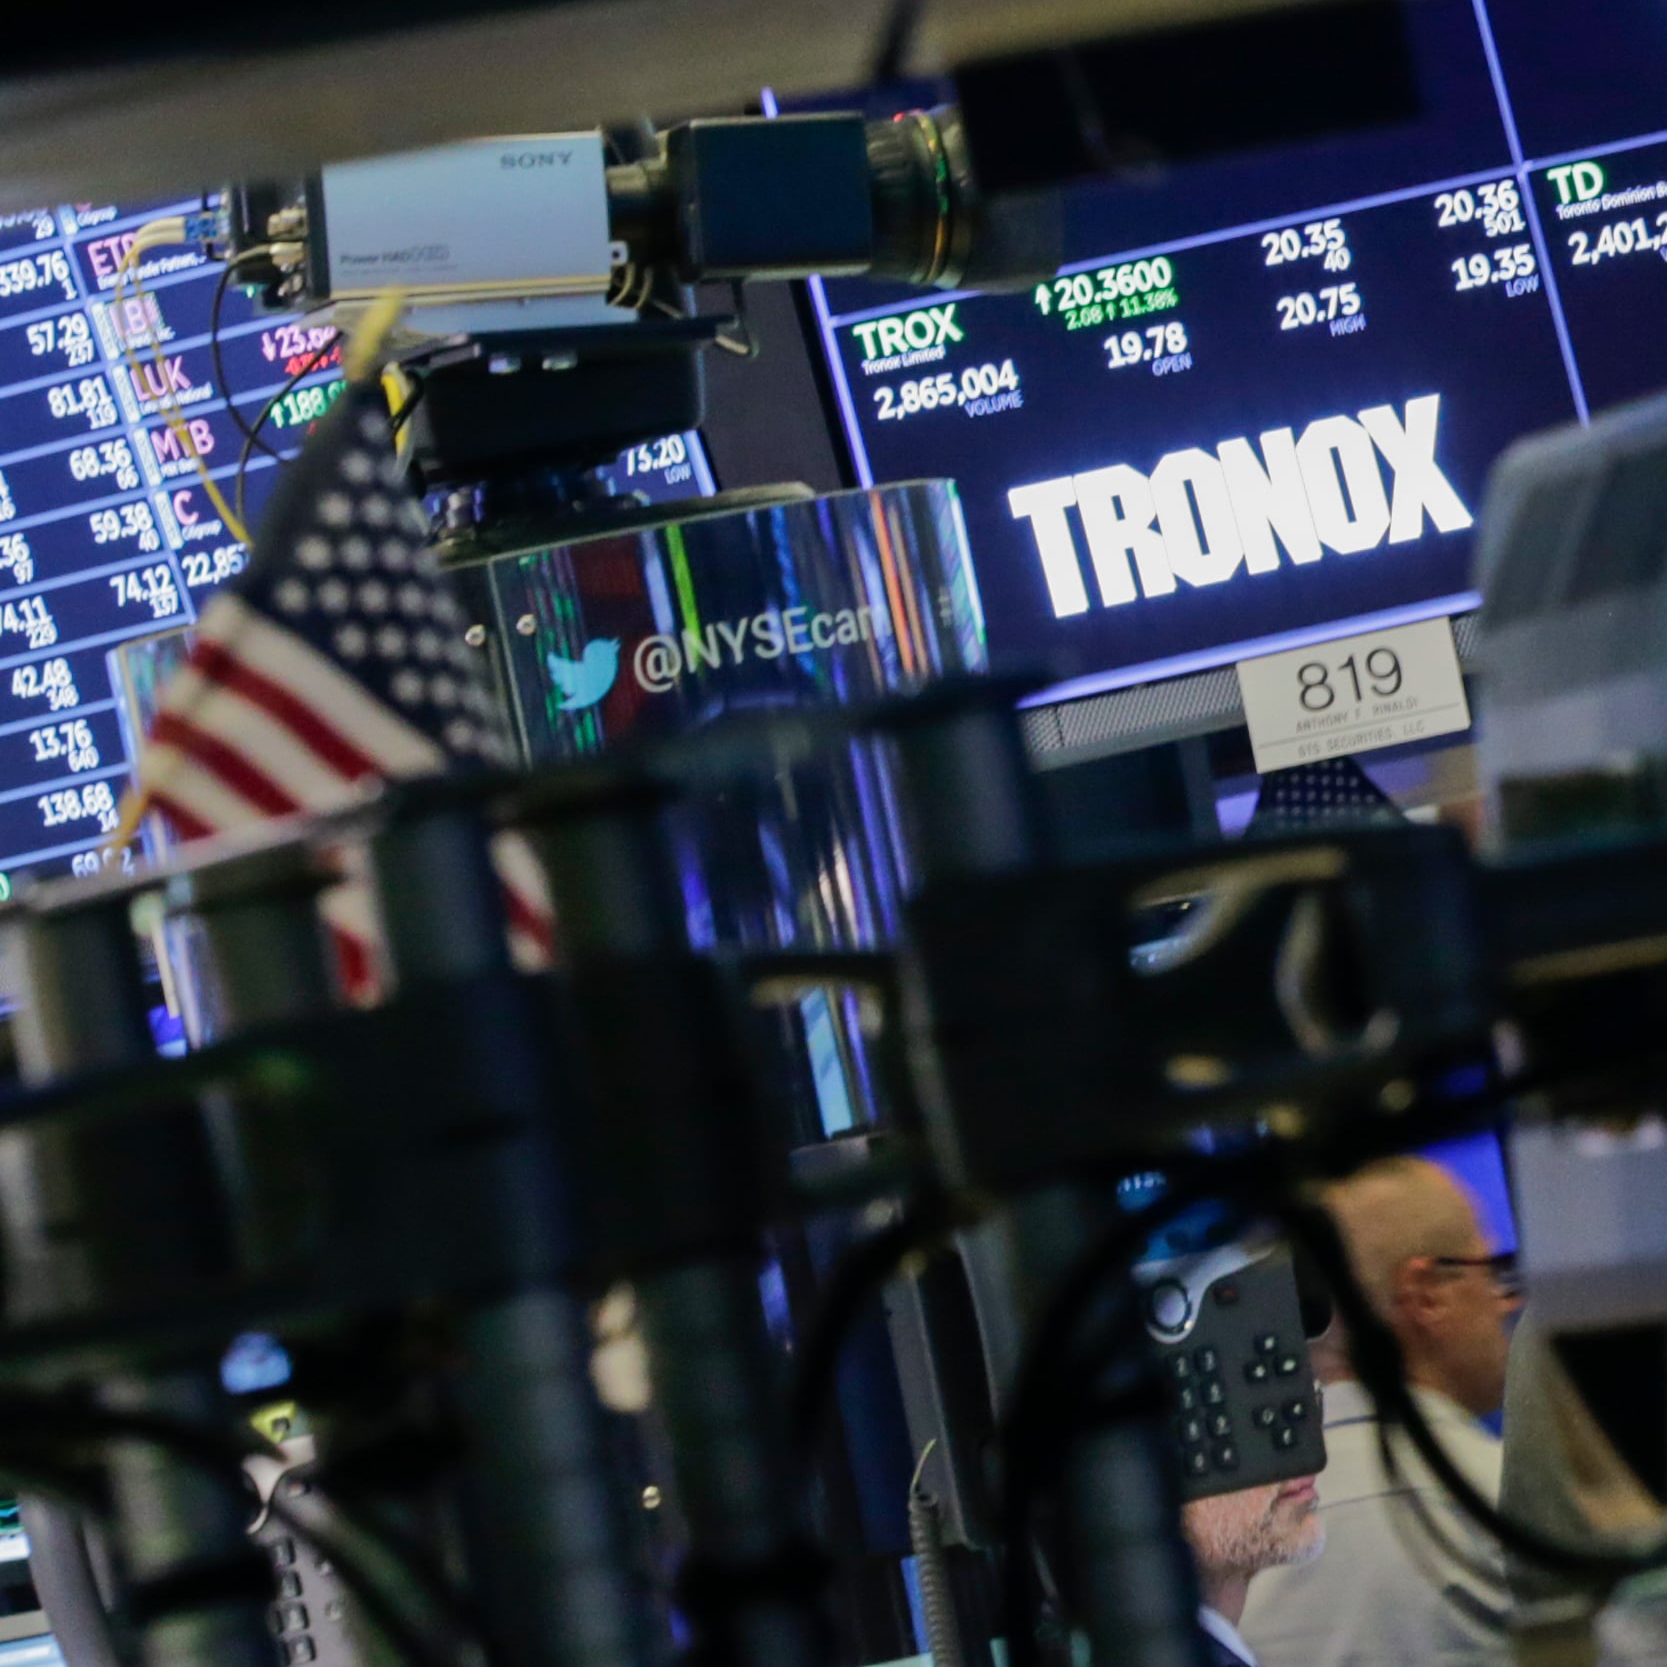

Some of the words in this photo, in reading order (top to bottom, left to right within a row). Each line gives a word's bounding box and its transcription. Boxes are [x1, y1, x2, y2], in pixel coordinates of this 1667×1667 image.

[500, 150, 572, 170] SONY
[1434, 180, 1519, 228] 20.36
[1547, 161, 1604, 206] TD
[1557, 200, 1599, 221] Toronto
[1602, 188, 1656, 212] Dominion
[1261, 218, 1345, 267] 20.35
[1484, 209, 1526, 238] 501
[1323, 247, 1352, 272] 40
[1451, 244, 1536, 291] 19.35
[1054, 257, 1172, 311] 20.3600
[1276, 282, 1361, 331] 20.75
[1505, 274, 1539, 298] LOW
[853, 303, 964, 360] TROX
[1104, 321, 1188, 369] 19.78
[1329, 313, 1366, 337] HIGH
[130, 355, 191, 402] LUK
[862, 352, 900, 375] Tronox
[902, 343, 945, 368] Limited
[1153, 353, 1193, 377] OPEN
[873, 358, 1020, 420] 2,865,004
[964, 390, 1024, 419] VOLUME
[174, 490, 199, 525] C
[1007, 393, 1474, 618] TRONOX
[12, 657, 72, 698] 42.48
[1297, 647, 1402, 712] 819
[1296, 711, 1348, 734] ANTHONY
[38, 781, 114, 827] 138.68
